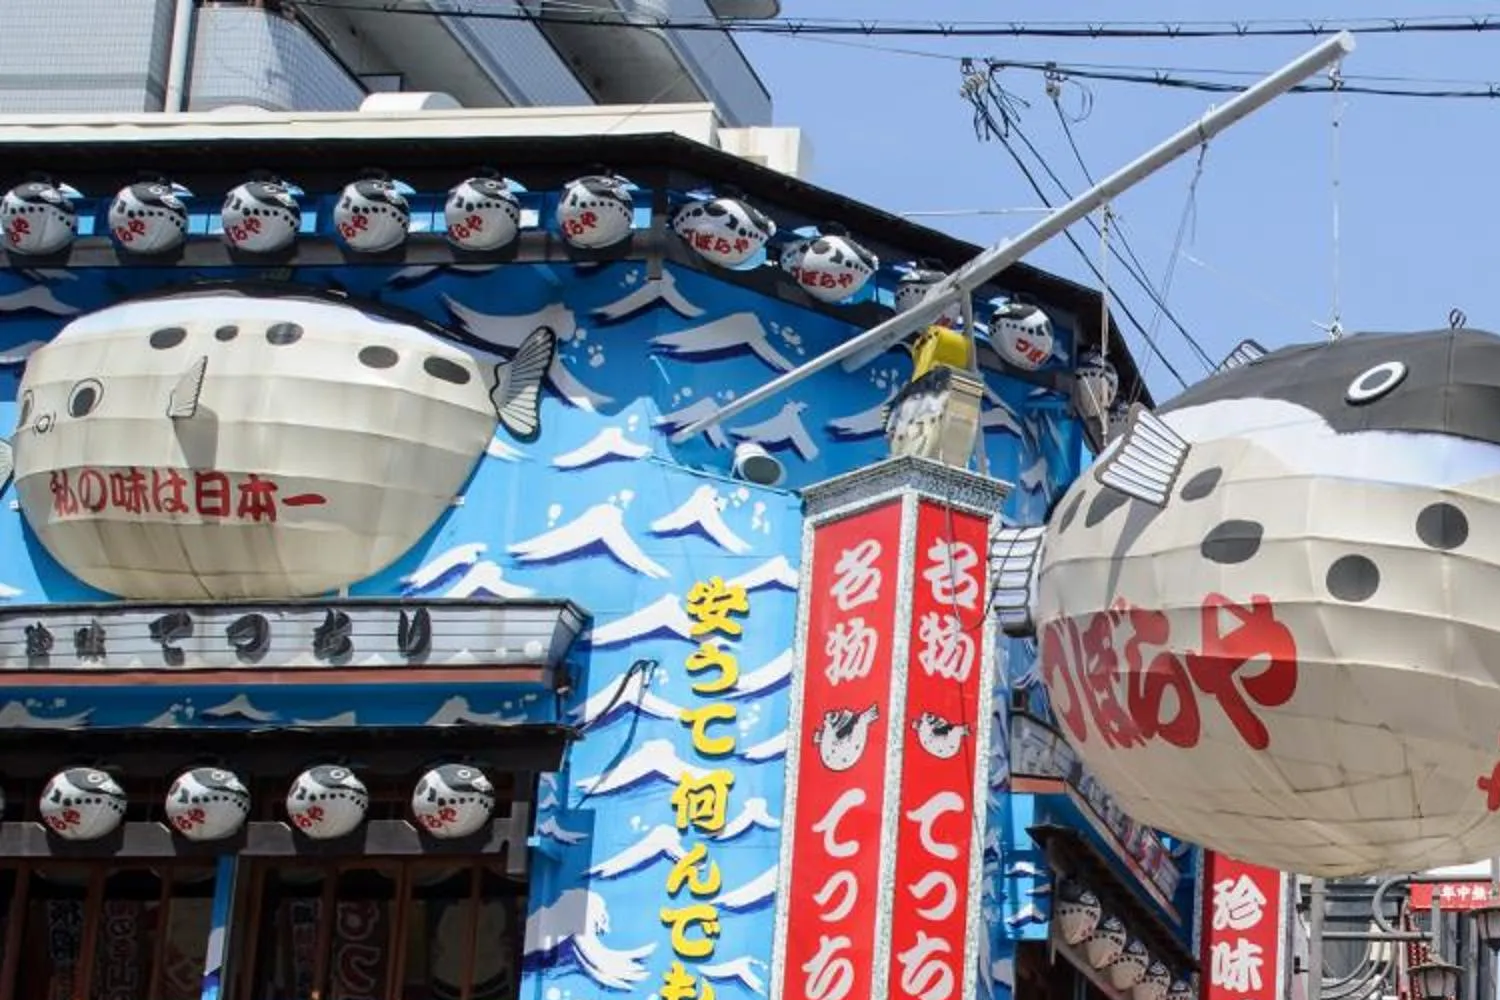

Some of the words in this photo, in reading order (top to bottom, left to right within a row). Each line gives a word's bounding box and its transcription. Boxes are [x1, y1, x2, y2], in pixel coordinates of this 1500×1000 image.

[50, 465, 327, 522] 私の味は日本一
[826, 538, 883, 687] 名物
[918, 536, 980, 683] 名物
